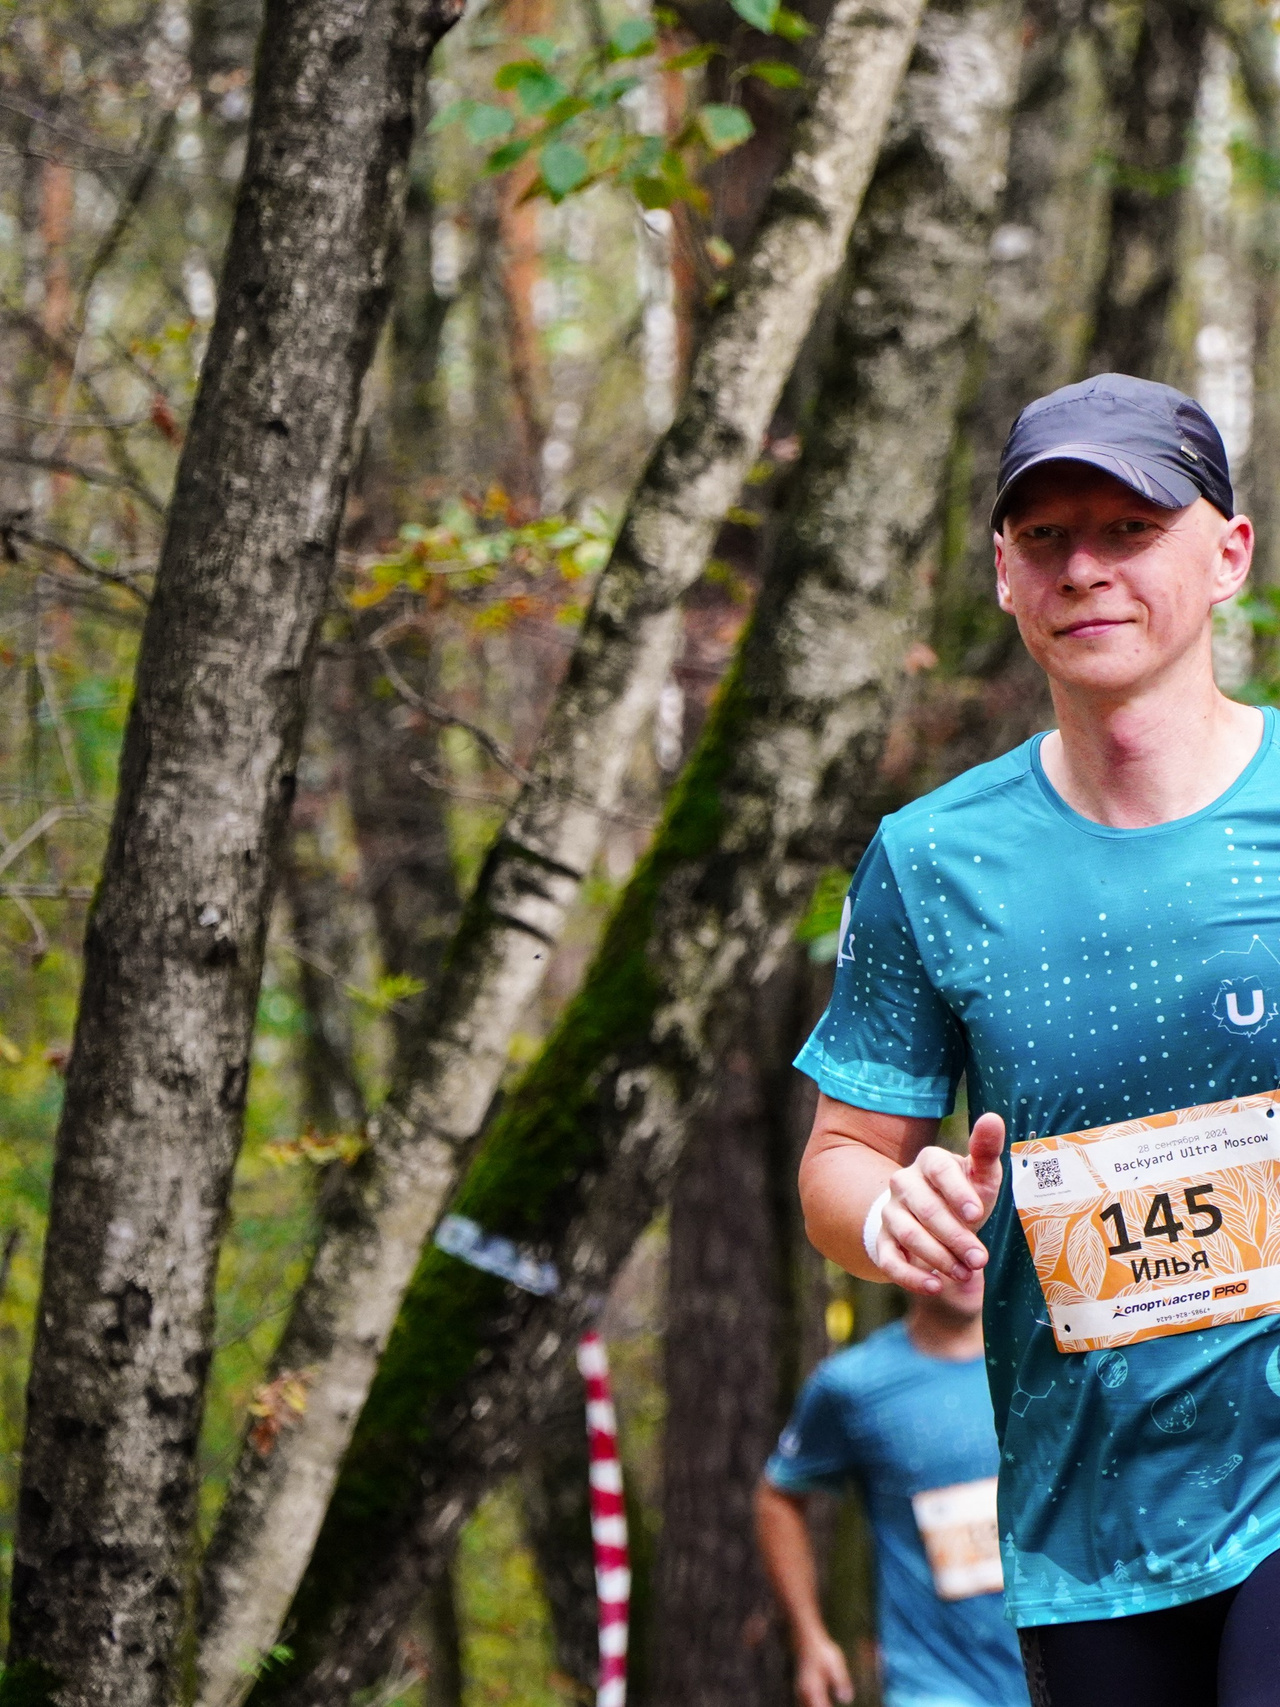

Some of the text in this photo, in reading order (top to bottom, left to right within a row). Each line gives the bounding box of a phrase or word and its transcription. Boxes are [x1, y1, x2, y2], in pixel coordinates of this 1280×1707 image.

[1225, 989, 1265, 1026] U
[1114, 1133, 1269, 1173] Backyard Ultra Moscow
[1138, 1128, 1228, 1153] 28 сентября 2024
[1099, 1183, 1223, 1256] 145
[1214, 1282, 1248, 1298] PRO
